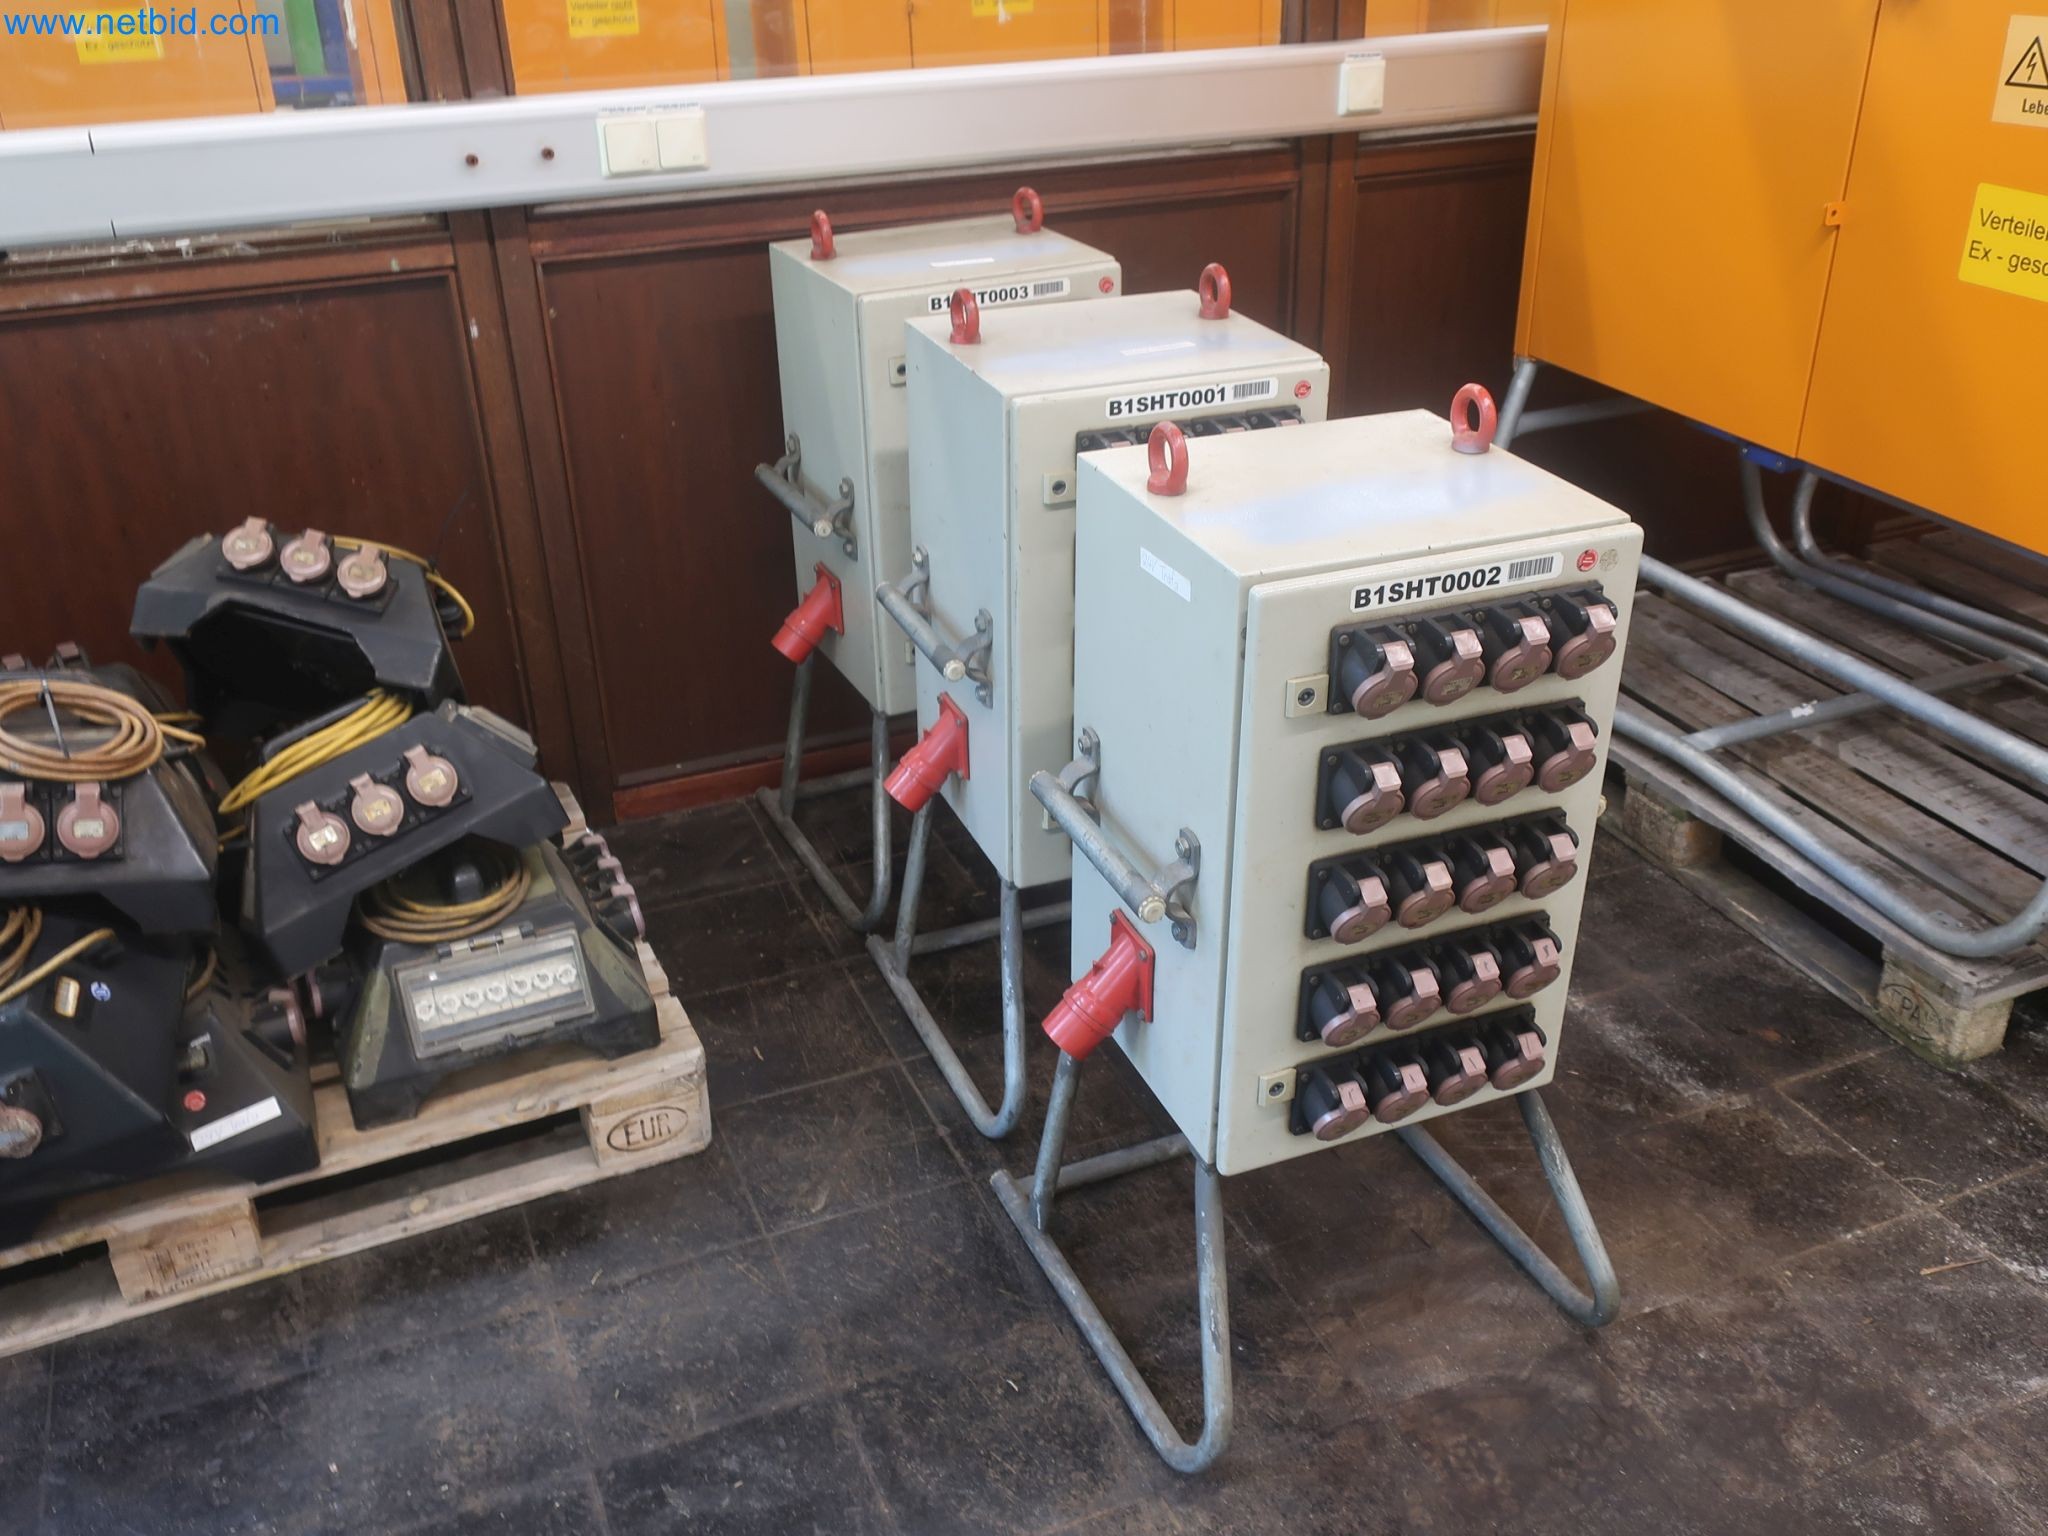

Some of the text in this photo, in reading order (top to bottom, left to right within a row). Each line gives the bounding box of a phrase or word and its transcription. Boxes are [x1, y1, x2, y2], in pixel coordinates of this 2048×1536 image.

[1968, 240, 1992, 262] Ex
[931, 286, 1029, 311] B1T0003
[1109, 387, 1226, 417] B1SHT0001
[1354, 566, 1502, 609] B1SHT0002
[624, 1112, 672, 1147] EUR
